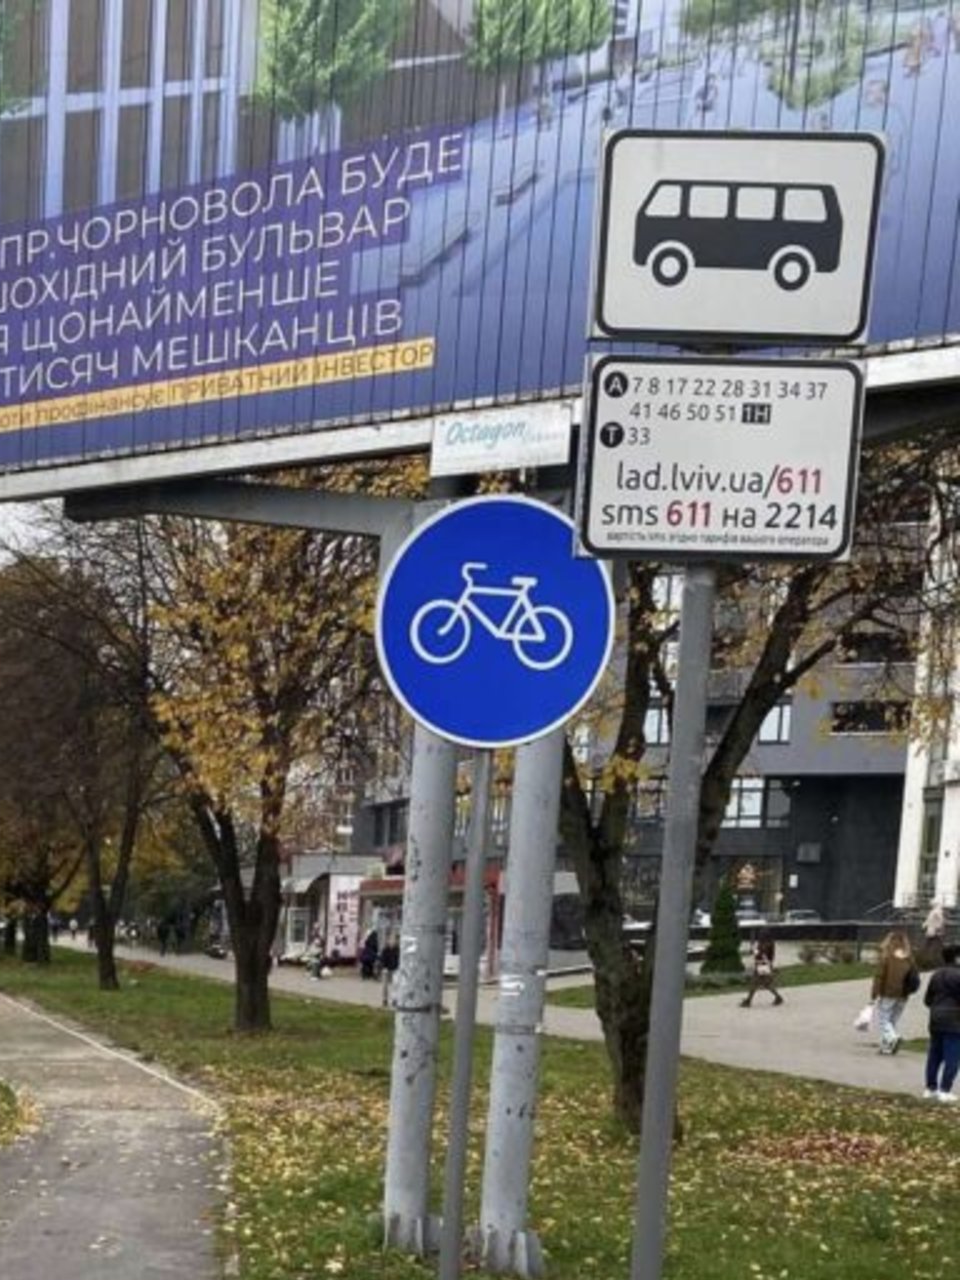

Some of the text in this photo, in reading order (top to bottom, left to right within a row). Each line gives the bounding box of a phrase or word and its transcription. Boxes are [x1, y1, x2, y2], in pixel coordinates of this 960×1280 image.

[0, 167, 324, 270] ПР.ЧОРНОВОЛА
[341, 133, 463, 194] БУДЕ
[201, 198, 411, 272] БУЛЬВАР
[22, 261, 340, 354] ЩОНАЙМЕНШЕ
[0, 350, 119, 398] ТИСЯЧ
[133, 300, 403, 376] МЕШКАНЦІВ
[171, 363, 308, 400] ПРИВАТНИЙ
[312, 346, 434, 379] ІНВЕСТОР
[633, 378, 643, 393] 7
[648, 378, 660, 394] 8
[668, 379, 688, 395] 17
[693, 379, 716, 395] 22
[722, 380, 743, 396] 28
[749, 381, 771, 397] 31
[778, 382, 801, 398] 34
[808, 383, 828, 399] 37
[630, 403, 651, 419] 41
[657, 403, 681, 420] 46
[687, 404, 710, 420] 50
[715, 405, 736, 421] 51
[628, 427, 651, 445] 33
[617, 461, 822, 498] lad.lviv.ua/611
[601, 501, 837, 530] sms 611 на 2214
